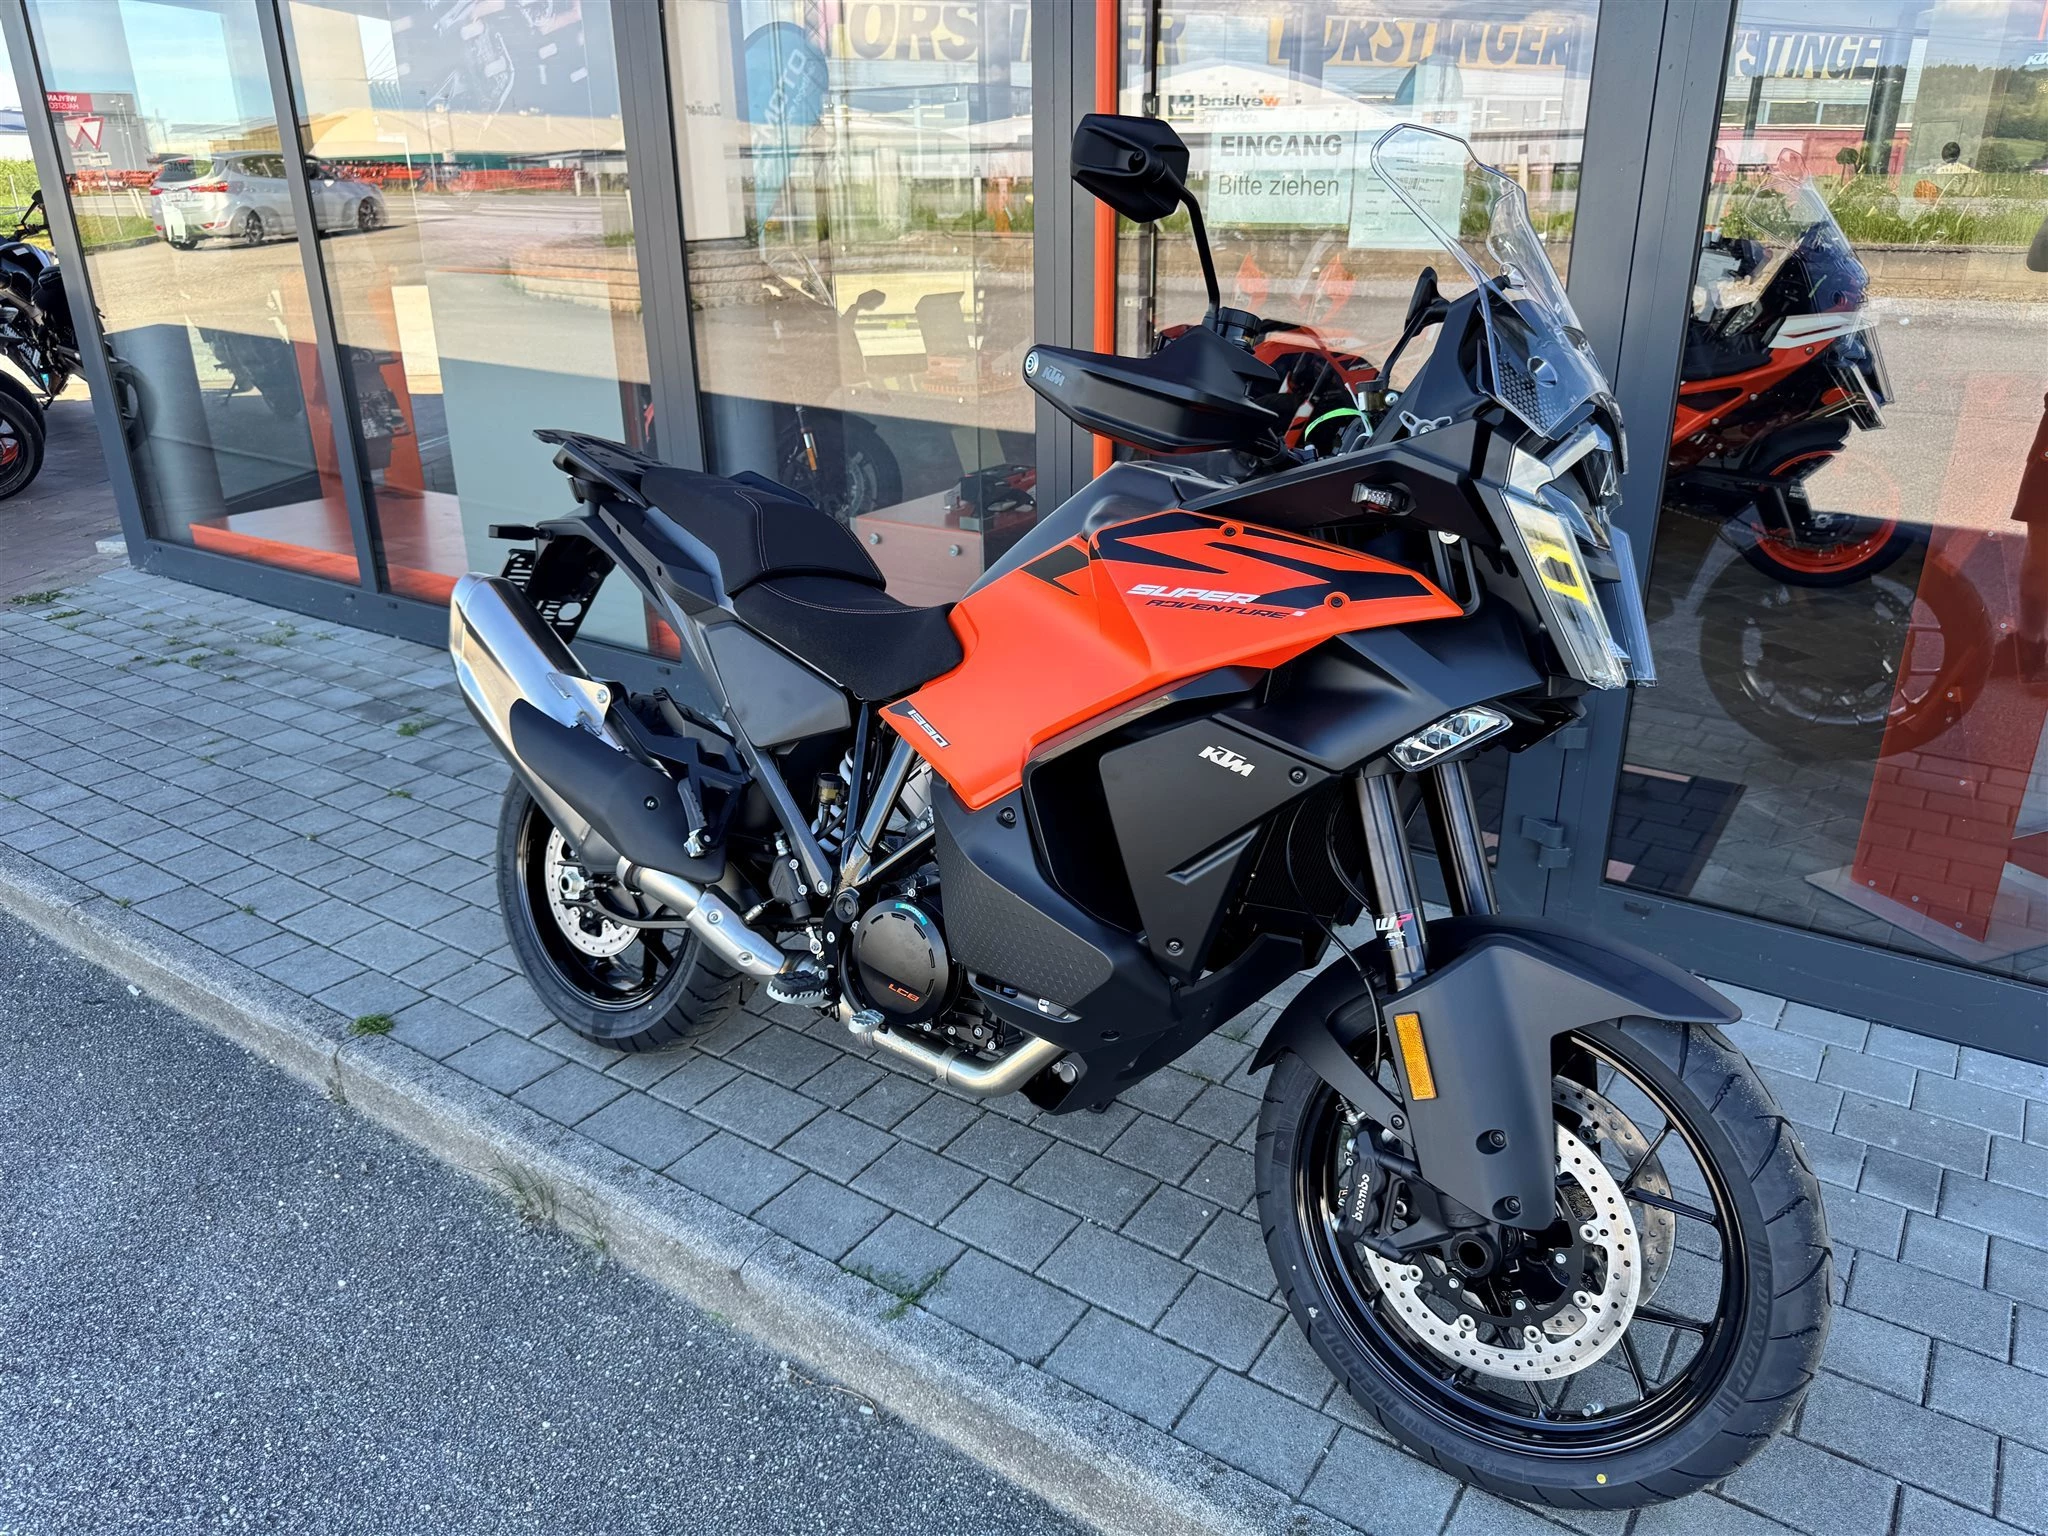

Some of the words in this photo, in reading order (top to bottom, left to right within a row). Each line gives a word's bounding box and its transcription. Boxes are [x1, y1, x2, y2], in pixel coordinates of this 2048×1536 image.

[1220, 134, 1342, 157] EINGANG
[1218, 174, 1263, 196] Bitte
[1268, 174, 1340, 196] ziehen
[1041, 365, 1065, 387] KTM
[1126, 583, 1261, 605] SUPER
[1145, 599, 1291, 619] ADVENTURE
[1198, 745, 1256, 778] KTM
[1375, 912, 1414, 931] WP
[1351, 1173, 1371, 1222] brembo
